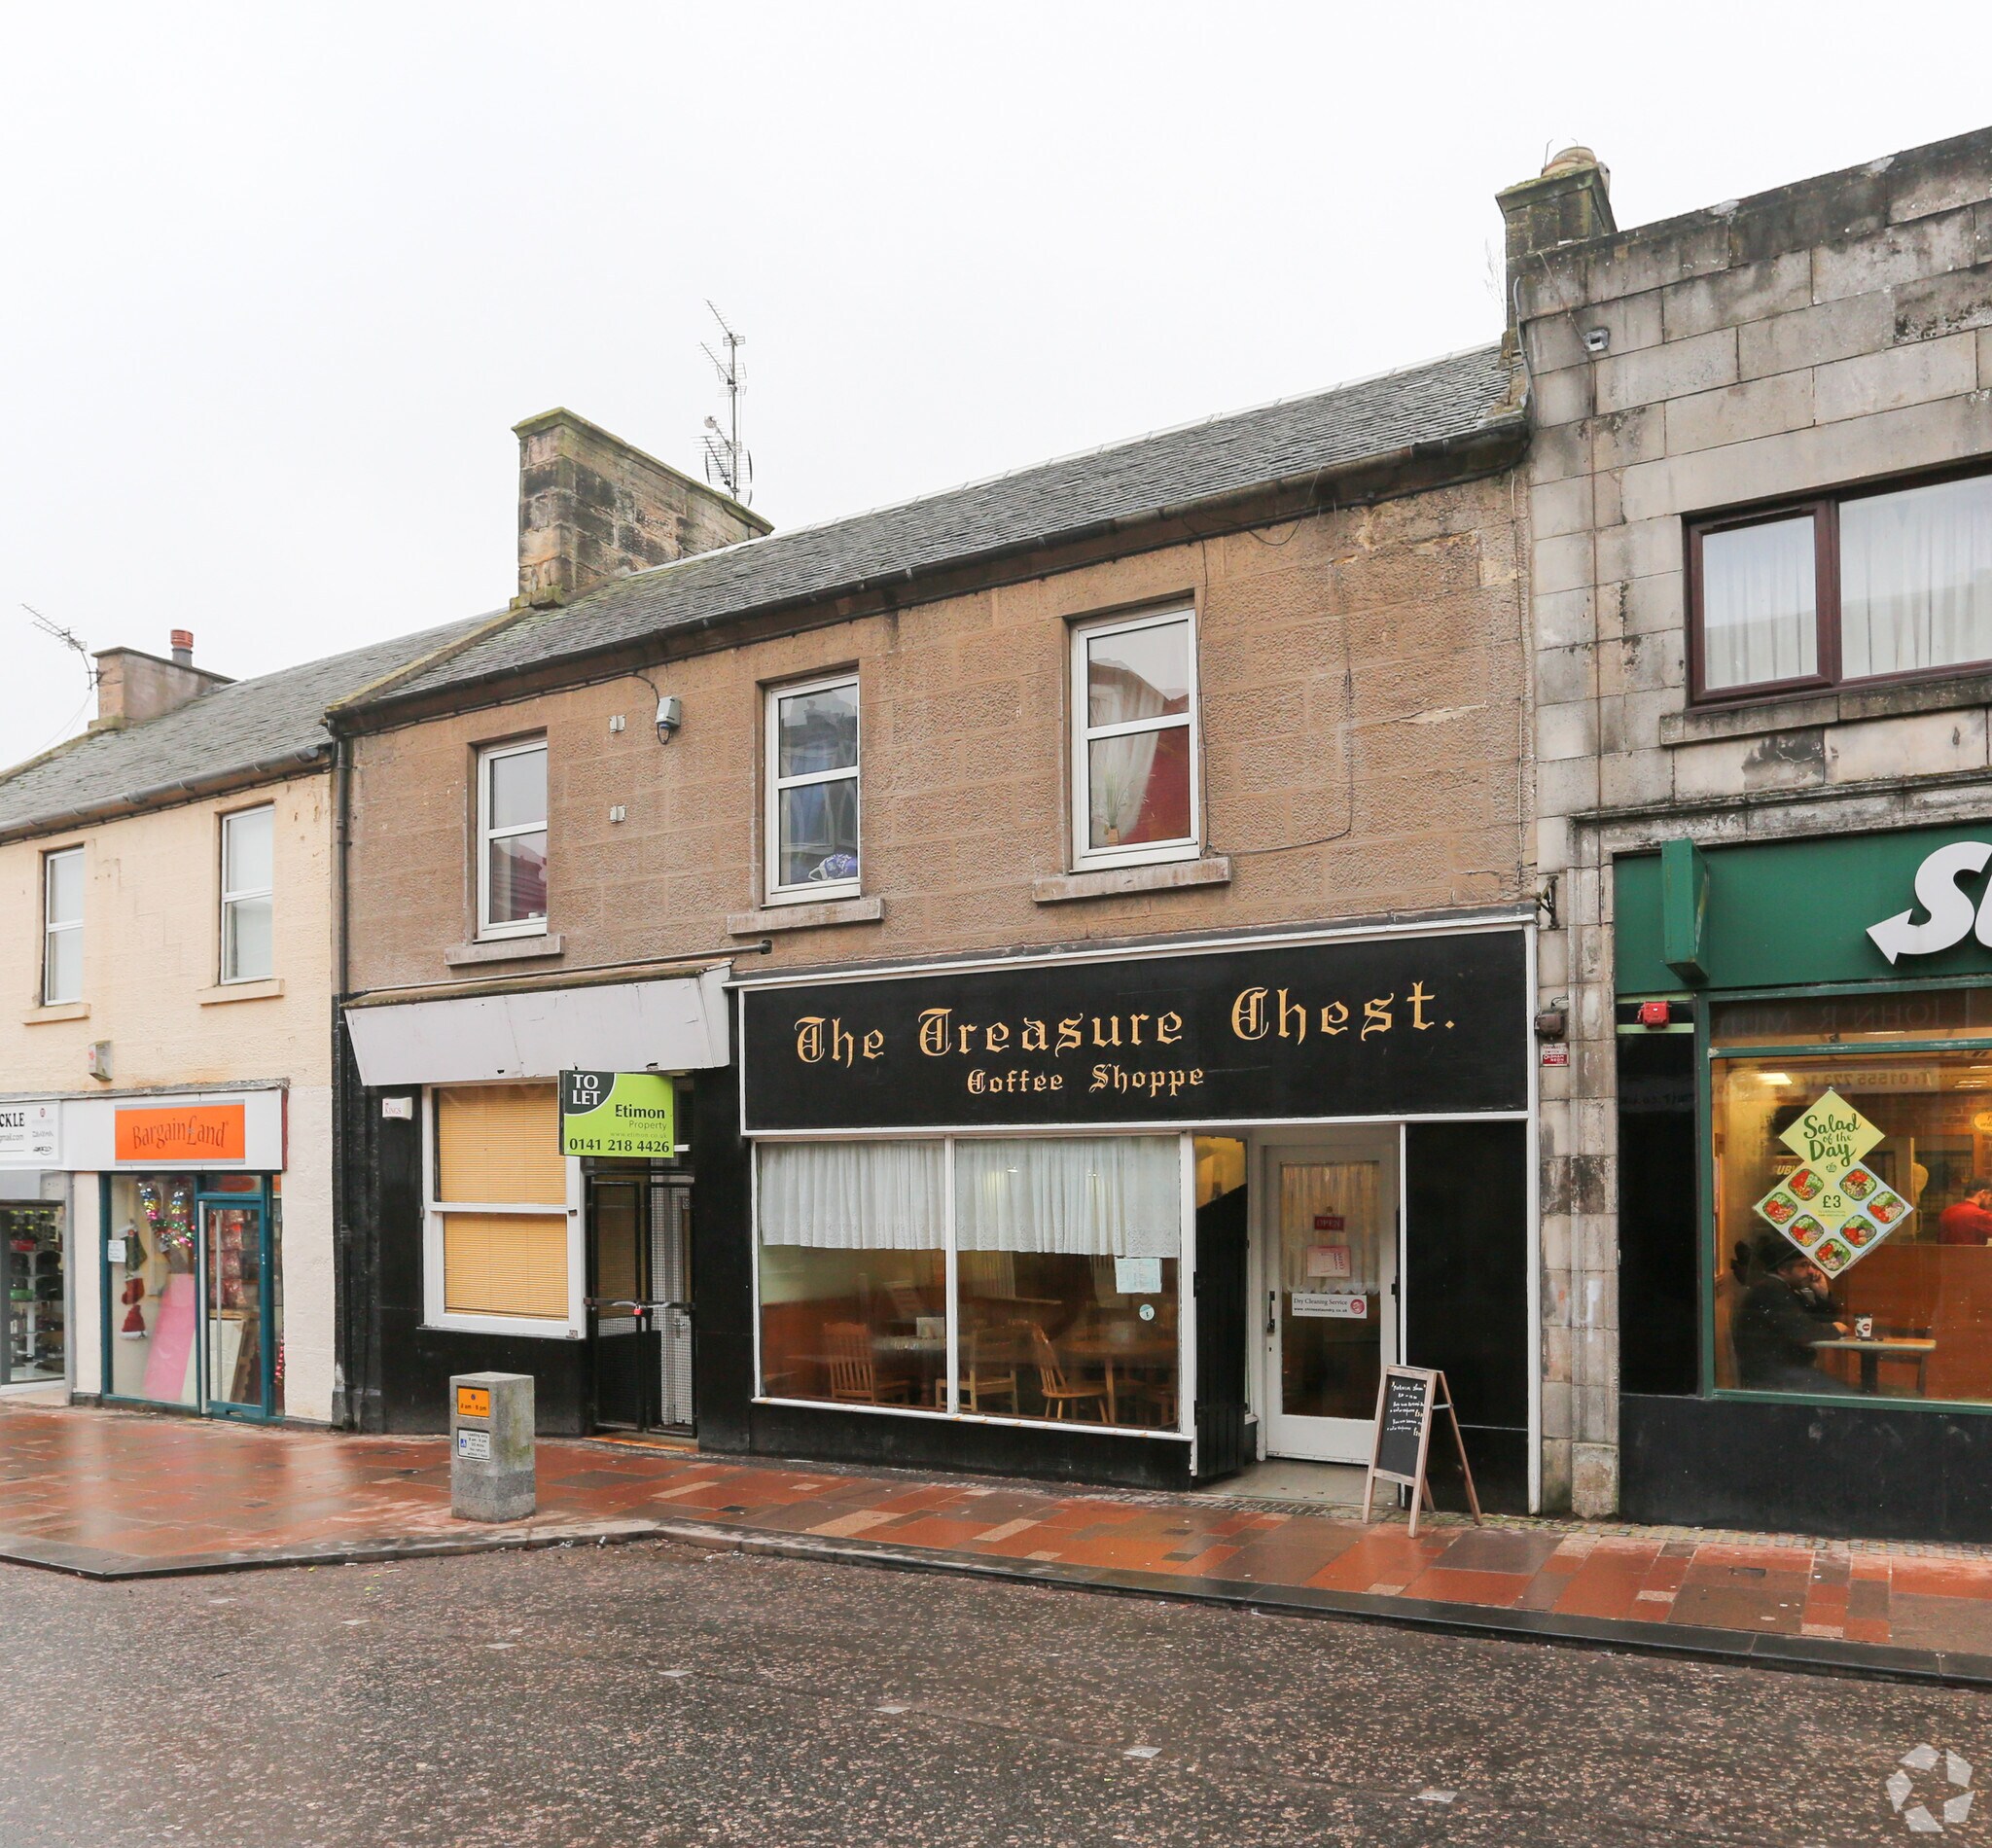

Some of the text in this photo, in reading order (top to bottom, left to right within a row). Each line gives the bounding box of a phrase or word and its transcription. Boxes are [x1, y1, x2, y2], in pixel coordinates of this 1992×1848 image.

[1866, 841, 1992, 966] S
[794, 980, 1456, 1068] The Treasure Chest.
[572, 1074, 599, 1089] TO
[967, 1063, 1205, 1098] Coffee Shoppe
[572, 1089, 601, 1105] LET
[615, 1104, 665, 1119] Etimon
[628, 1120, 667, 1130] Property
[1803, 1113, 1862, 1139] Salad
[569, 1138, 669, 1153] 0141 218 4426
[1822, 1131, 1853, 1145] of the
[1809, 1139, 1857, 1167] Day
[1822, 1194, 1841, 1209] £3
[1316, 1219, 1341, 1227] OPEN
